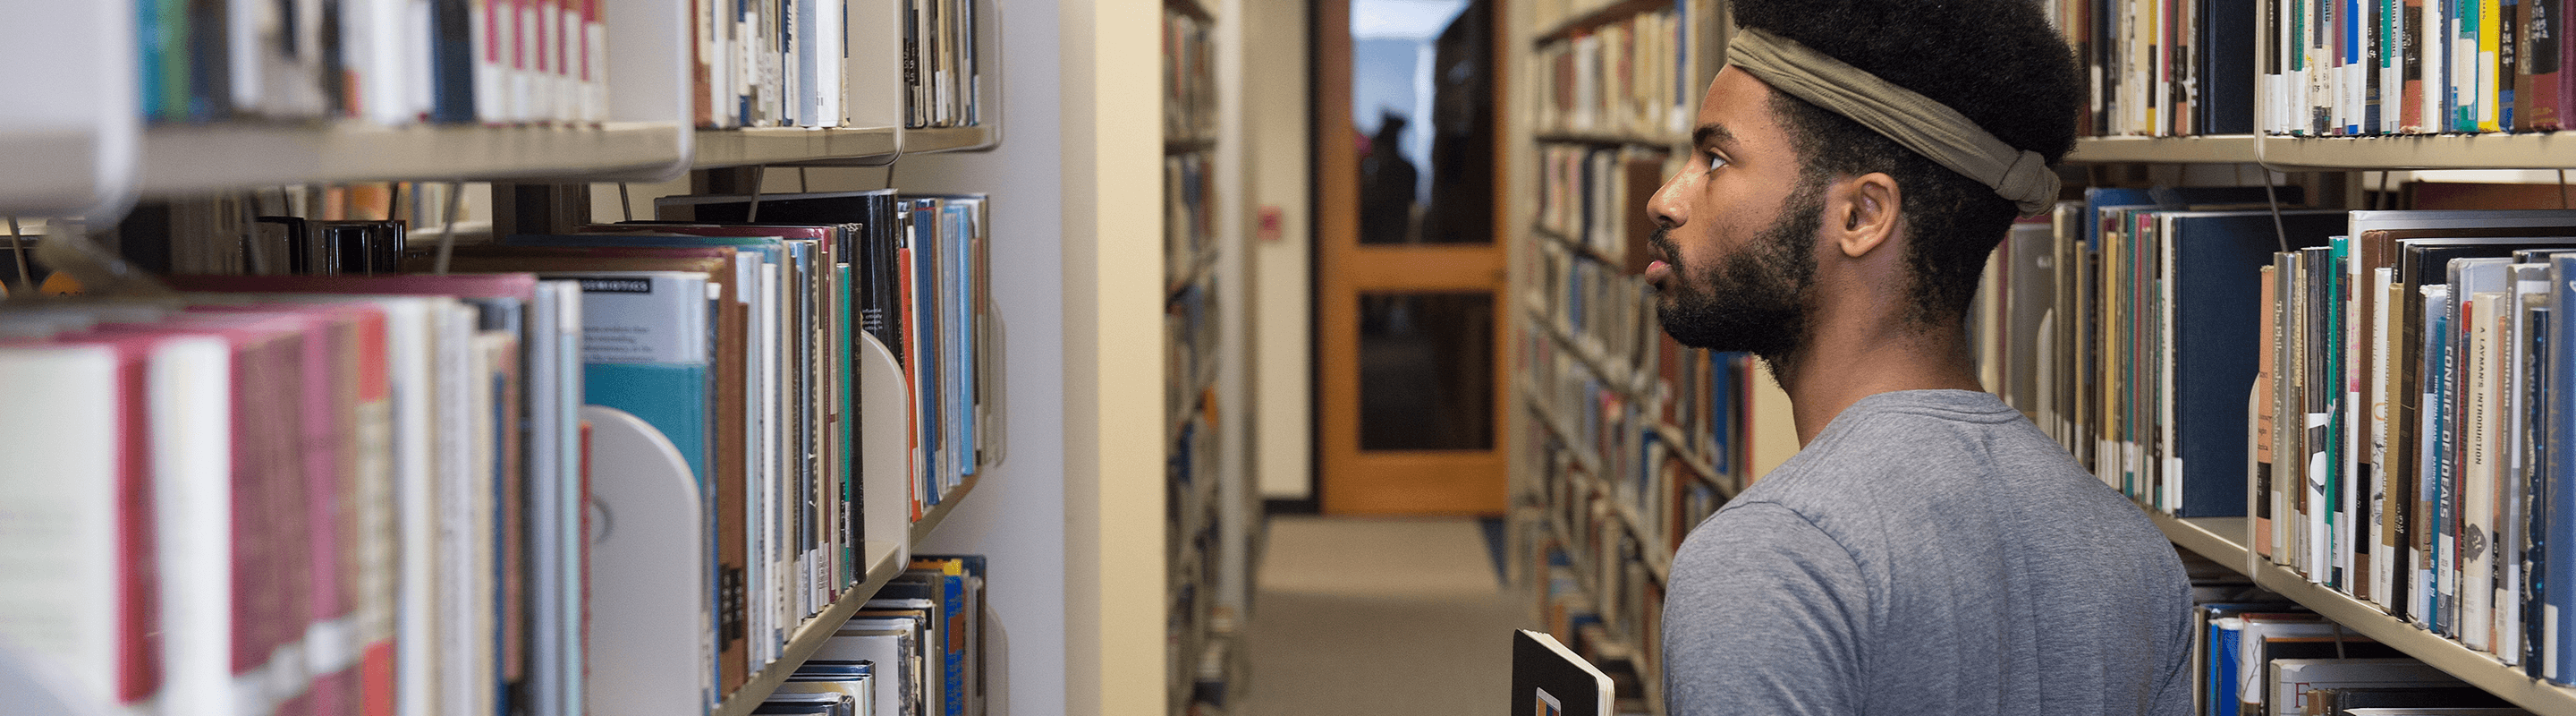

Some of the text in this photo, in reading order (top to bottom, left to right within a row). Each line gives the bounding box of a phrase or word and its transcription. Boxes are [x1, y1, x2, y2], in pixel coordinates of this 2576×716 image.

[2273, 300, 2283, 460] The Philosophy of Evolution
[2478, 338, 2486, 388] LAYMAN'S
[2504, 329, 2512, 407] EXISTENTIALISM
[2440, 345, 2453, 518] CONFLICT OF IDEALS
[2475, 393, 2485, 465] INTRODUCTION
